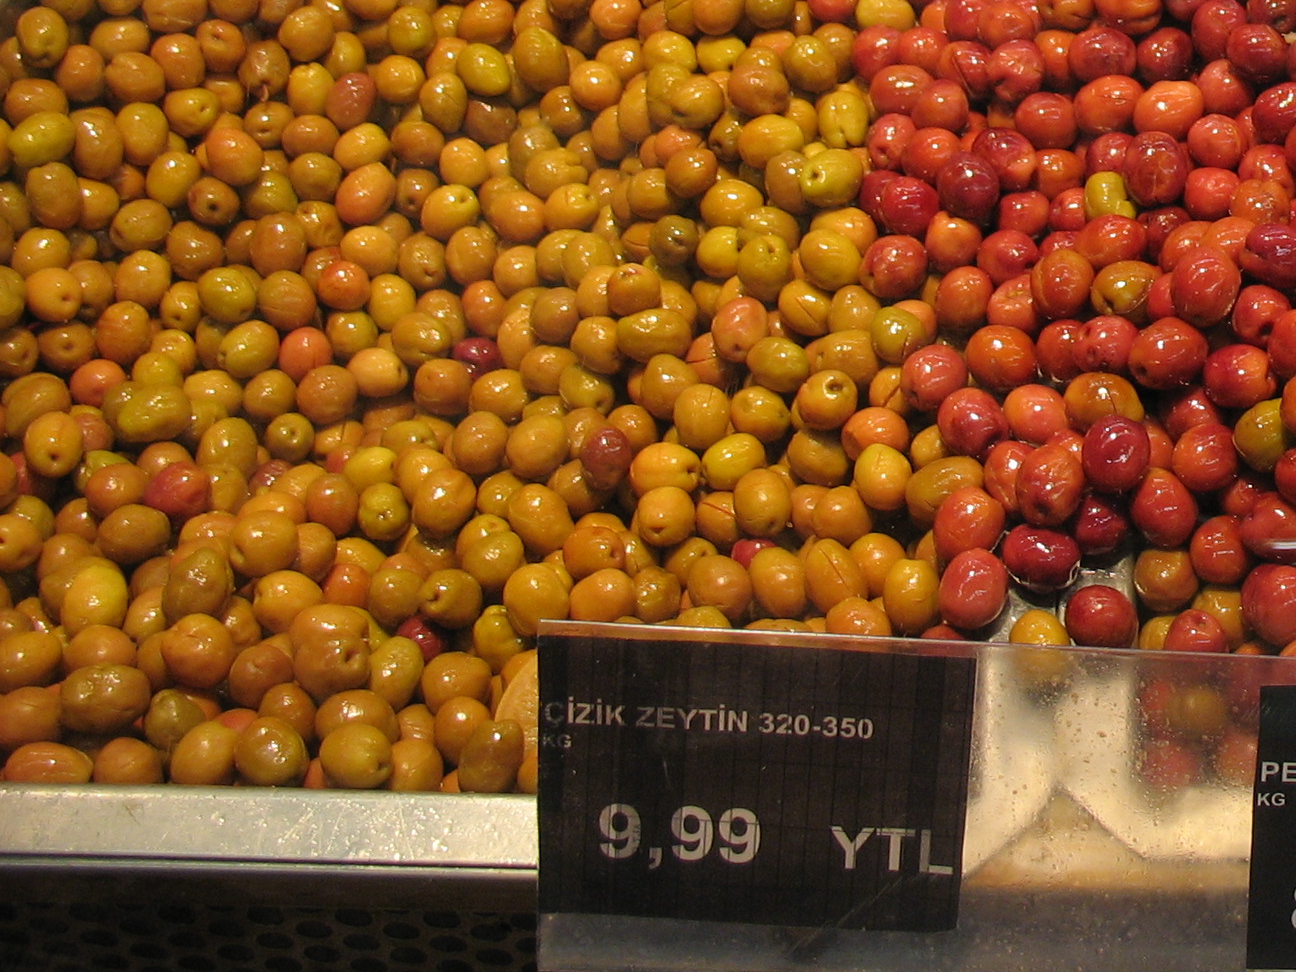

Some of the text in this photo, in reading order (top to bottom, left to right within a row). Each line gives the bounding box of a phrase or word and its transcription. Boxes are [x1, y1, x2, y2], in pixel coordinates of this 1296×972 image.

[544, 696, 874, 739] ÇİZİK ZEYTİN 320-350
[543, 735, 572, 749] KG
[1257, 793, 1286, 806] KG
[599, 803, 953, 875] 9,99 YTL
